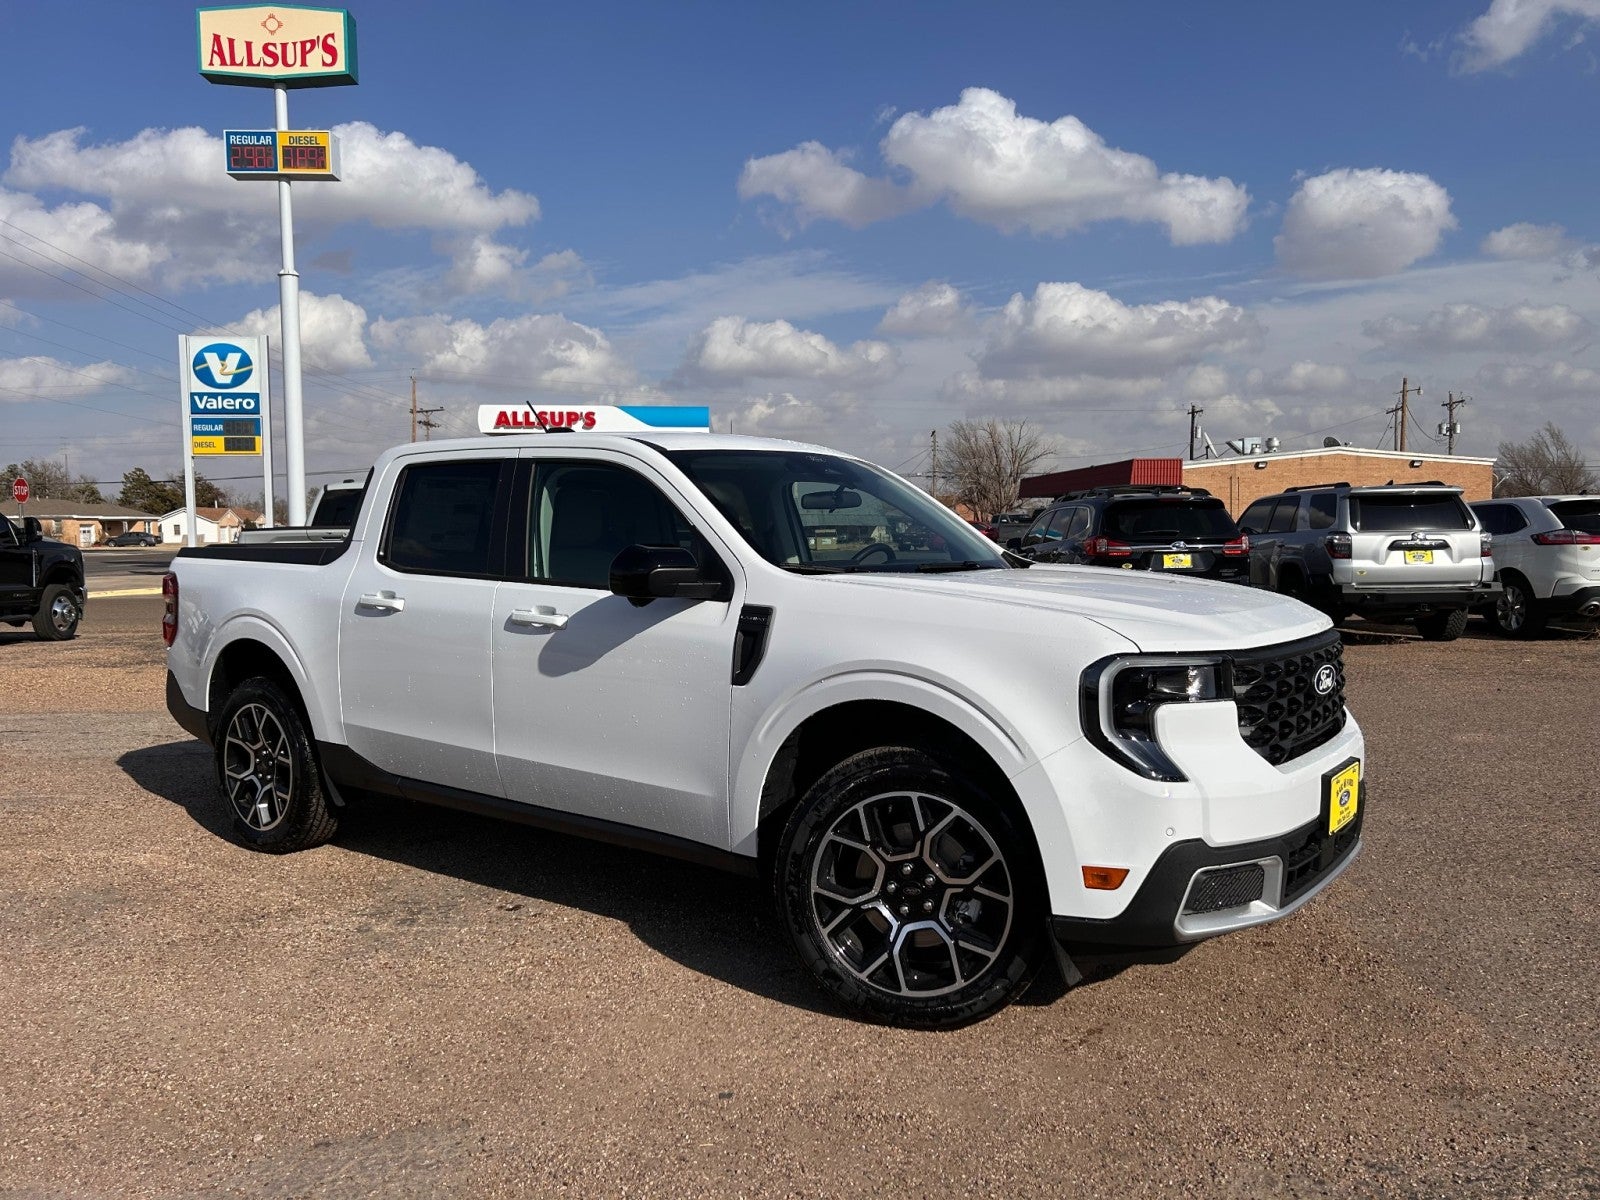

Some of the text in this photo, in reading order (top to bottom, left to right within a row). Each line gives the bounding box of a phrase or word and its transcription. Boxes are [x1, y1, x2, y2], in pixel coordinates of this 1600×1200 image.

[208, 32, 338, 67] ALLSUP'S
[230, 135, 272, 145] REGULAR
[288, 136, 320, 145] DIESEL
[193, 396, 255, 410] Valero
[494, 410, 596, 429] ALLSUP'S
[14, 485, 28, 495] STOP
